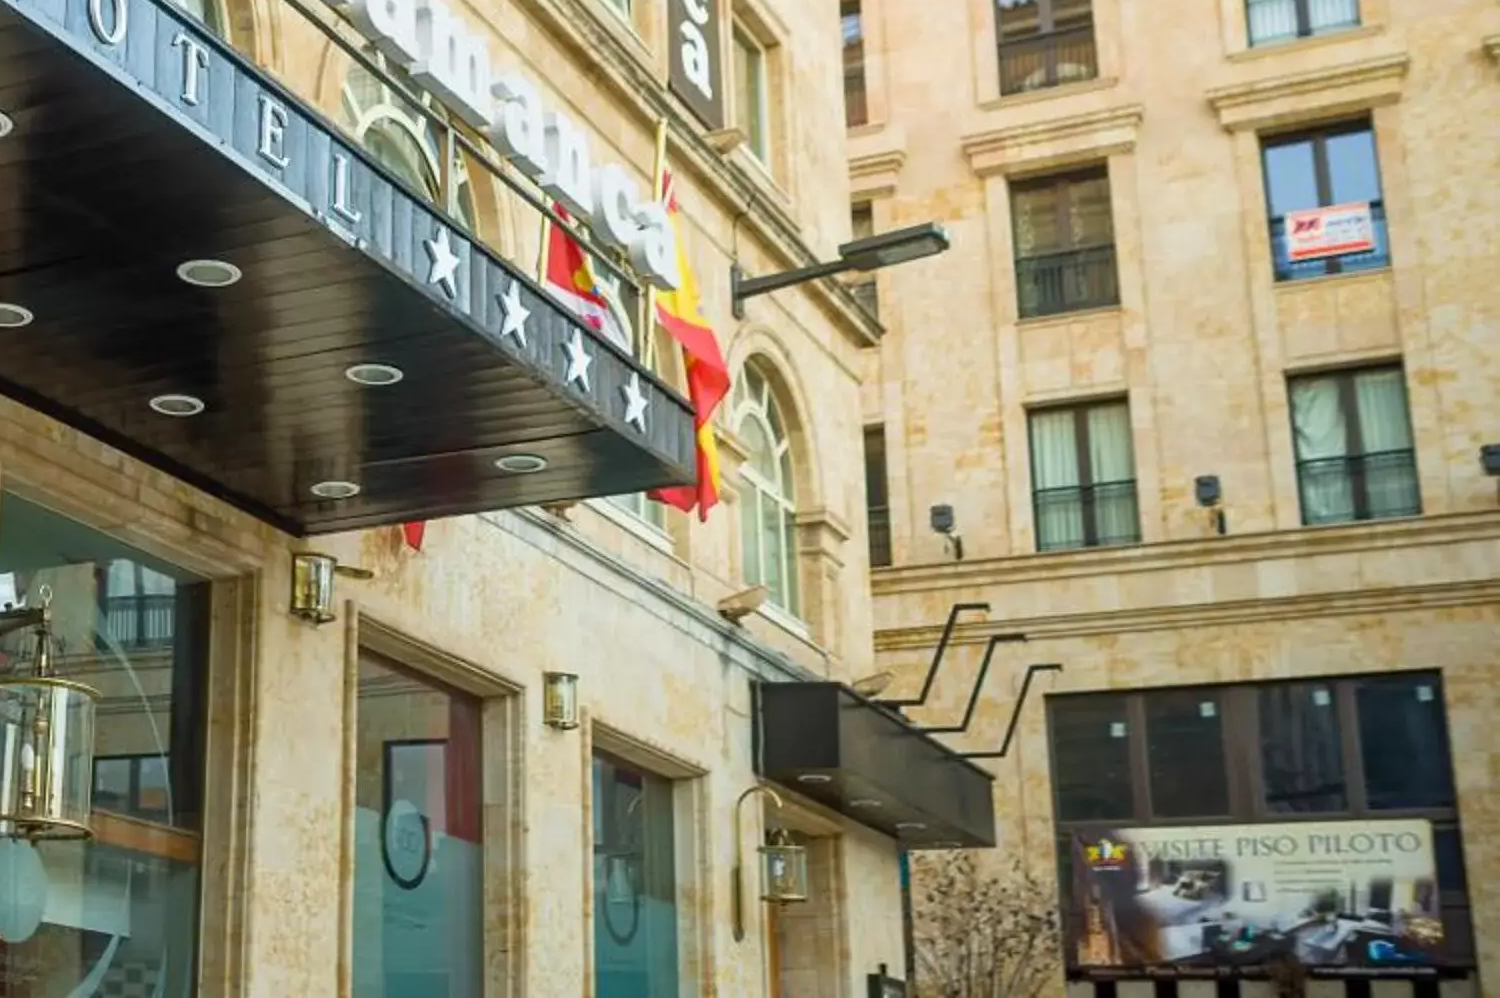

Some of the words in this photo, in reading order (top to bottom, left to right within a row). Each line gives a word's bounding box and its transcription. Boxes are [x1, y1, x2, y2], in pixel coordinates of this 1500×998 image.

[1139, 837, 1225, 860] VISITE
[1236, 834, 1299, 858] PISO
[1308, 831, 1422, 854] PILOTO
